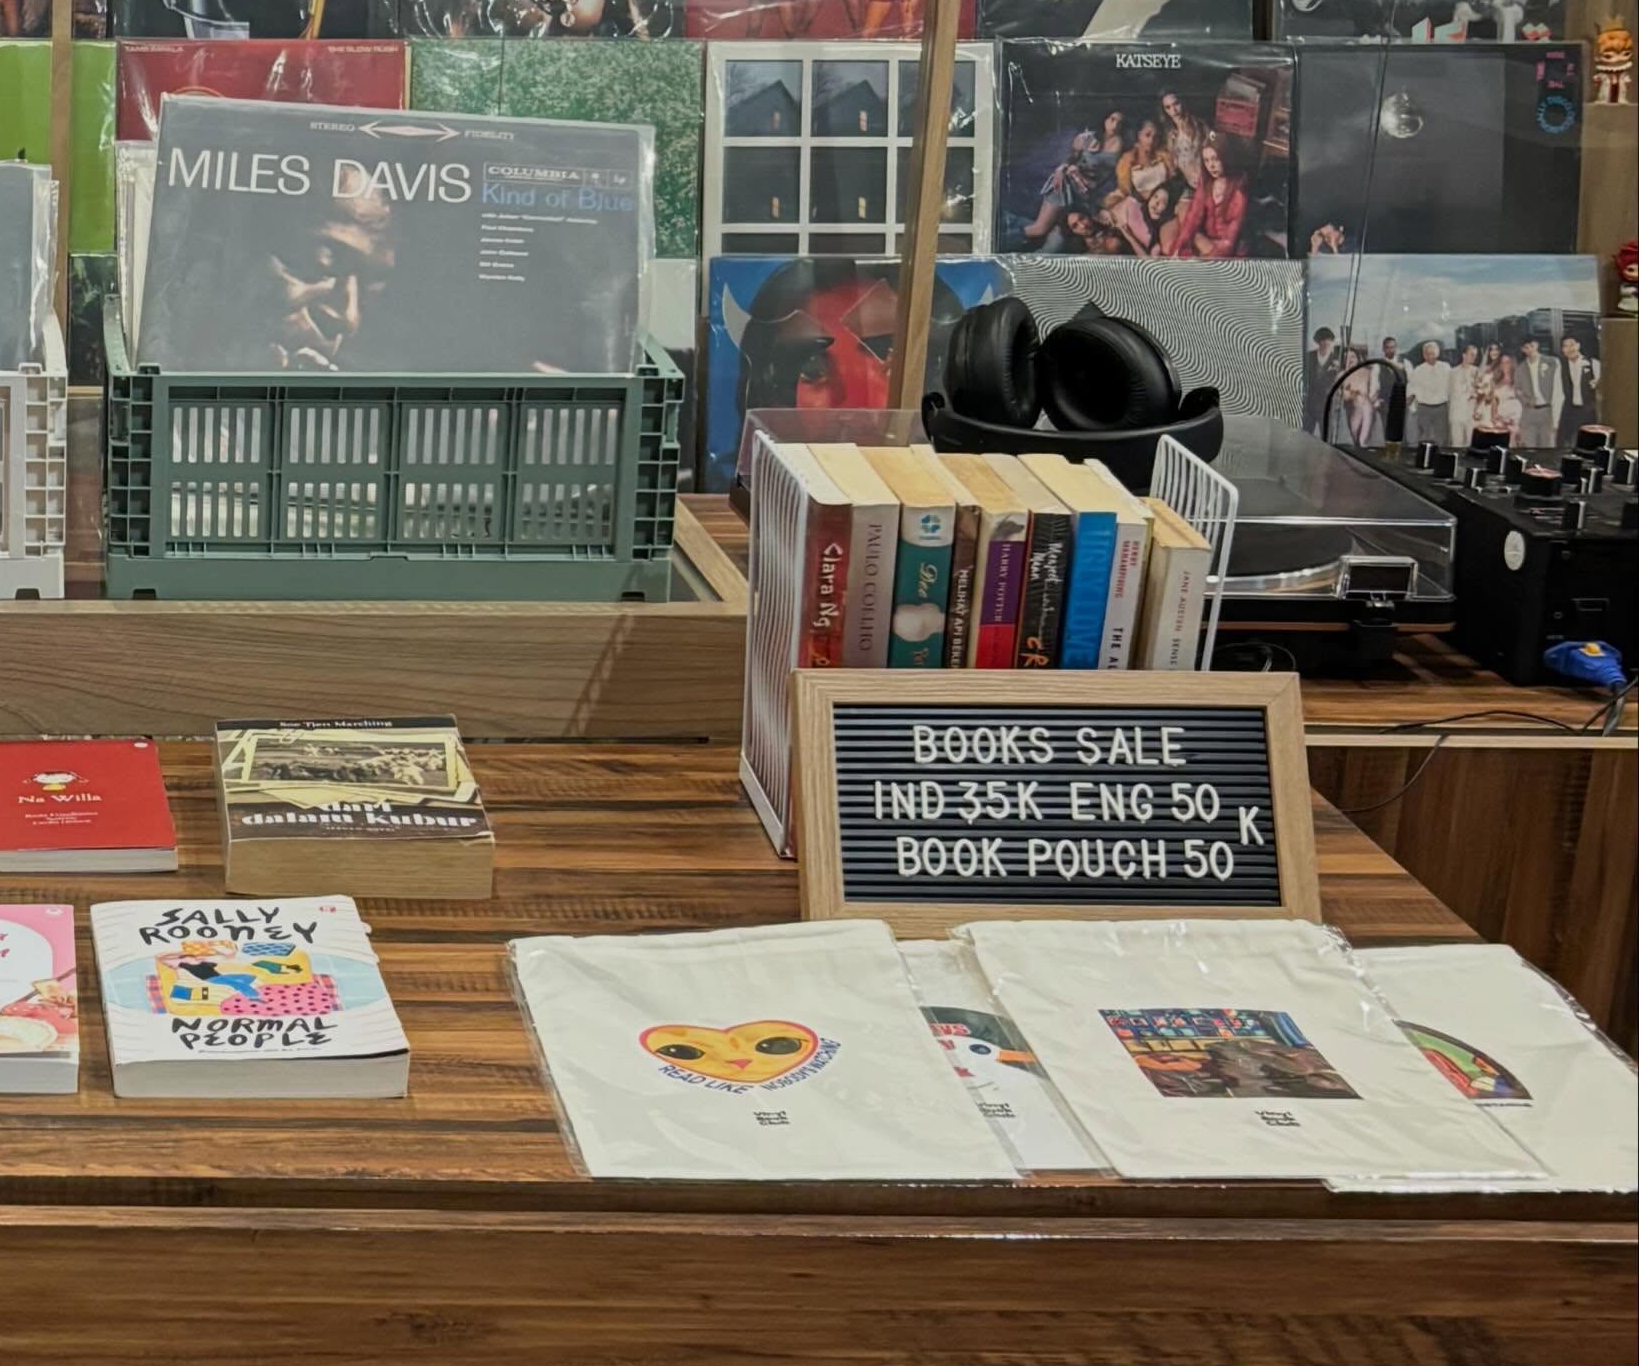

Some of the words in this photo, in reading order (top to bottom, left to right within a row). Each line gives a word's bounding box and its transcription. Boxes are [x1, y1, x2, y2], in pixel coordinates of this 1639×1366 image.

[1115, 53, 1182, 68] KATSEYE
[310, 122, 355, 133] STEREO
[168, 147, 311, 196] MILES
[332, 158, 472, 203] DAVIS
[488, 166, 581, 180] COLUMBIA
[482, 184, 536, 207] Kind
[546, 190, 570, 208] of
[578, 188, 635, 211] Blue
[863, 523, 882, 577] PAULO
[998, 543, 1011, 579] HARRY
[818, 542, 842, 596] Clara
[916, 562, 937, 599] Dee
[1179, 570, 1191, 593] JANE
[953, 569, 968, 616] MELIHAT
[993, 581, 1006, 623] POTTER
[812, 602, 838, 628] Ng
[858, 581, 877, 652] COELHO
[952, 618, 962, 636] API
[1172, 596, 1187, 632] AUSTEN
[1063, 601, 1100, 664] LOVE
[1109, 627, 1123, 650] THE
[1167, 638, 1180, 666] SENSE
[913, 725, 1054, 765] BOOKS
[1076, 726, 1187, 766] SALE
[18, 795, 46, 804] Na
[51, 793, 102, 803] Willa
[874, 781, 945, 821] IND
[957, 781, 1045, 824] 35K
[1070, 783, 1154, 823] ENG
[1171, 783, 1220, 823] 50
[242, 812, 355, 825] dalam
[366, 812, 478, 827] kubur
[1239, 805, 1265, 846] K
[897, 837, 1008, 877] BOOK
[1028, 838, 1168, 880] POUCH
[1183, 840, 1235, 881] 50
[155, 906, 280, 927] SALLY
[171, 1016, 338, 1035] NORMAL
[179, 1032, 334, 1050] PEOPLE
[658, 1065, 707, 1085] READ
[704, 1079, 749, 1095] LIKE
